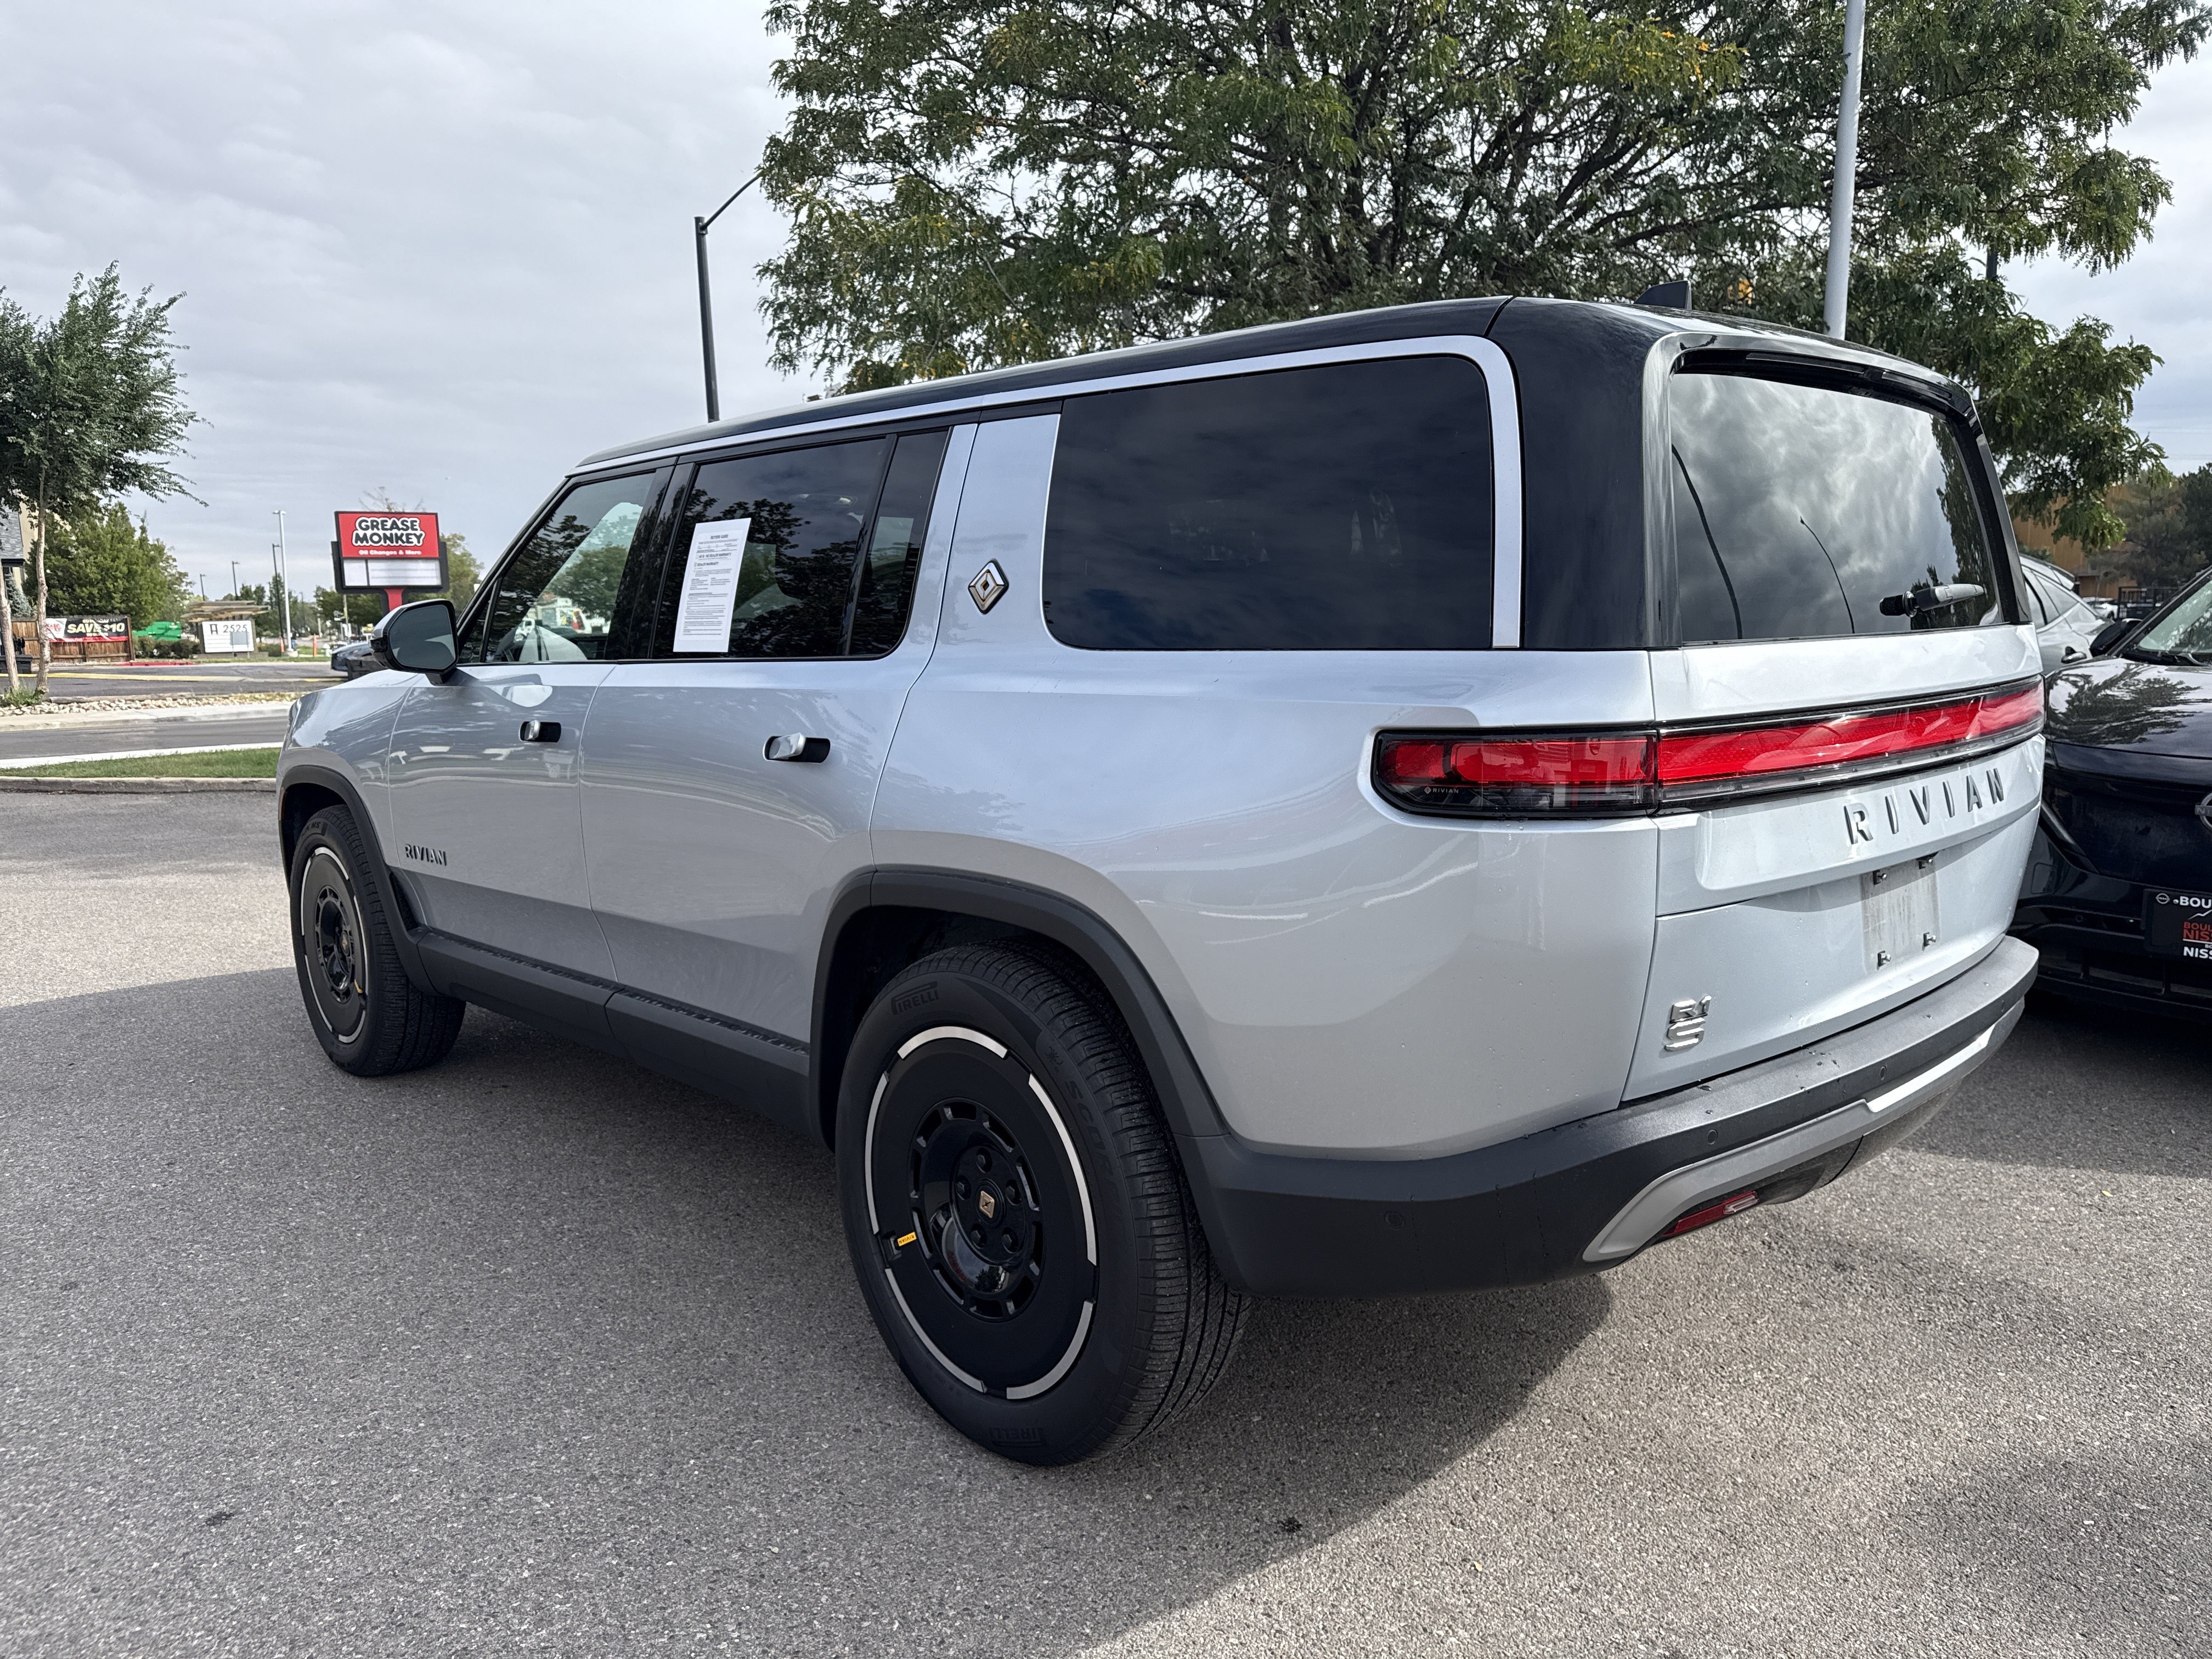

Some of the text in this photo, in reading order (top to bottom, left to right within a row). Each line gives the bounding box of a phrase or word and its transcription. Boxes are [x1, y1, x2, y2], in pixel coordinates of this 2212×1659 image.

[357, 518, 419, 532] GREASE
[354, 532, 424, 544] MONKEY
[223, 624, 247, 633] 2525
[1843, 768, 2004, 845] RIVIAN
[405, 844, 447, 866] RIVIAN
[2183, 929, 2212, 941] NIS
[890, 981, 940, 1015] PIRELLI
[899, 1234, 915, 1244] RIVIAN
